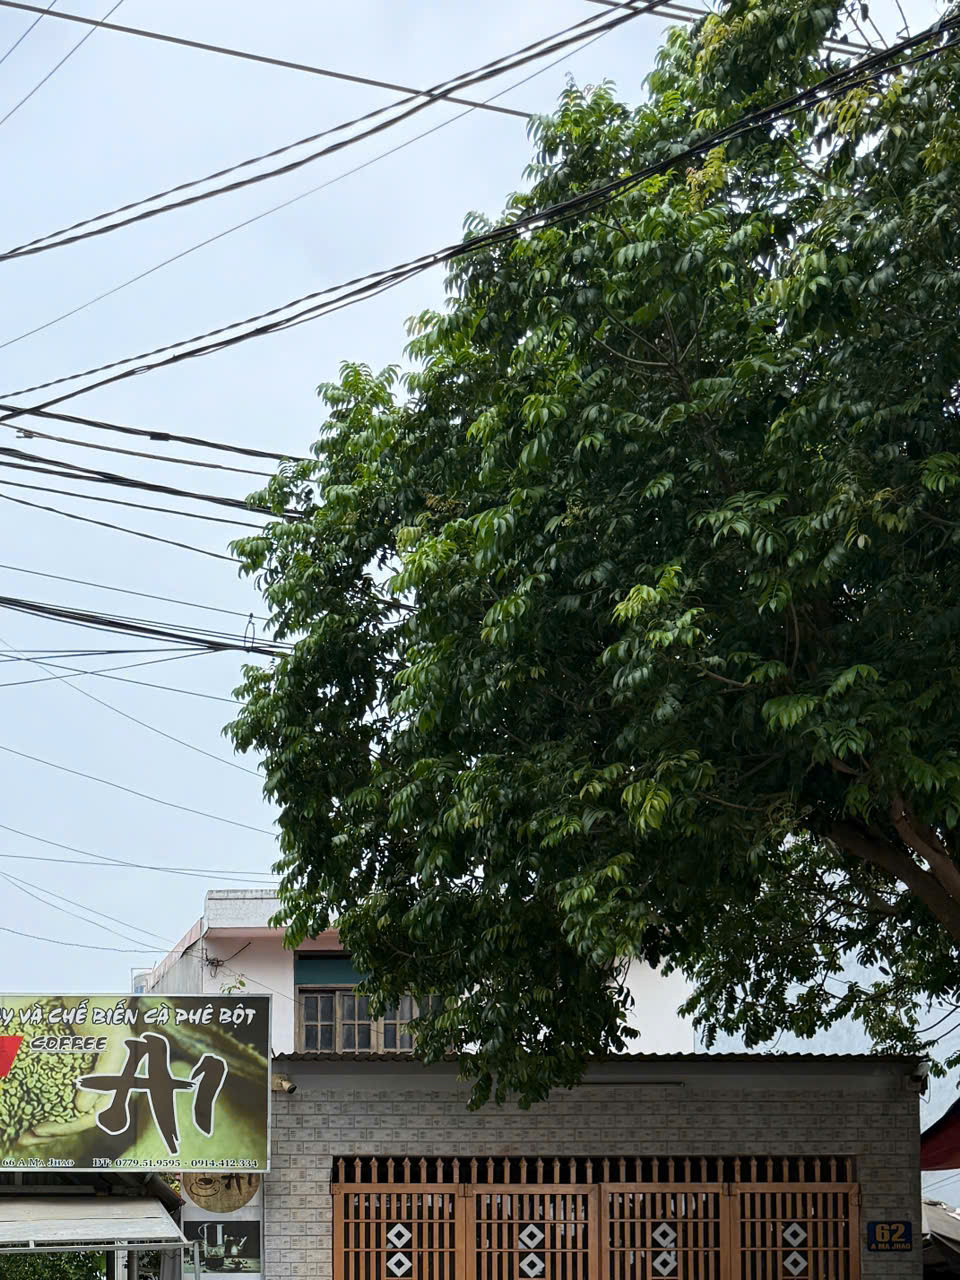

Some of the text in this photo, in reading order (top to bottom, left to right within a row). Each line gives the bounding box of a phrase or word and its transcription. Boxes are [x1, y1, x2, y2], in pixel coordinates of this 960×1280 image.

[19, 1003, 44, 1025] VÀ
[48, 1000, 89, 1025] CHẾ
[92, 1000, 138, 1025] BIẾN
[143, 1003, 170, 1026] CÀ
[175, 1003, 214, 1026] PHÊ
[219, 1003, 256, 1028] BỘT
[30, 1036, 107, 1051] COFFEE
[75, 1032, 228, 1156] A1
[2, 1158, 16, 1167] 66
[115, 1158, 181, 1168] 0779.51.9595
[191, 1158, 258, 1168] 0914.412.334
[875, 1223, 905, 1242] 62
